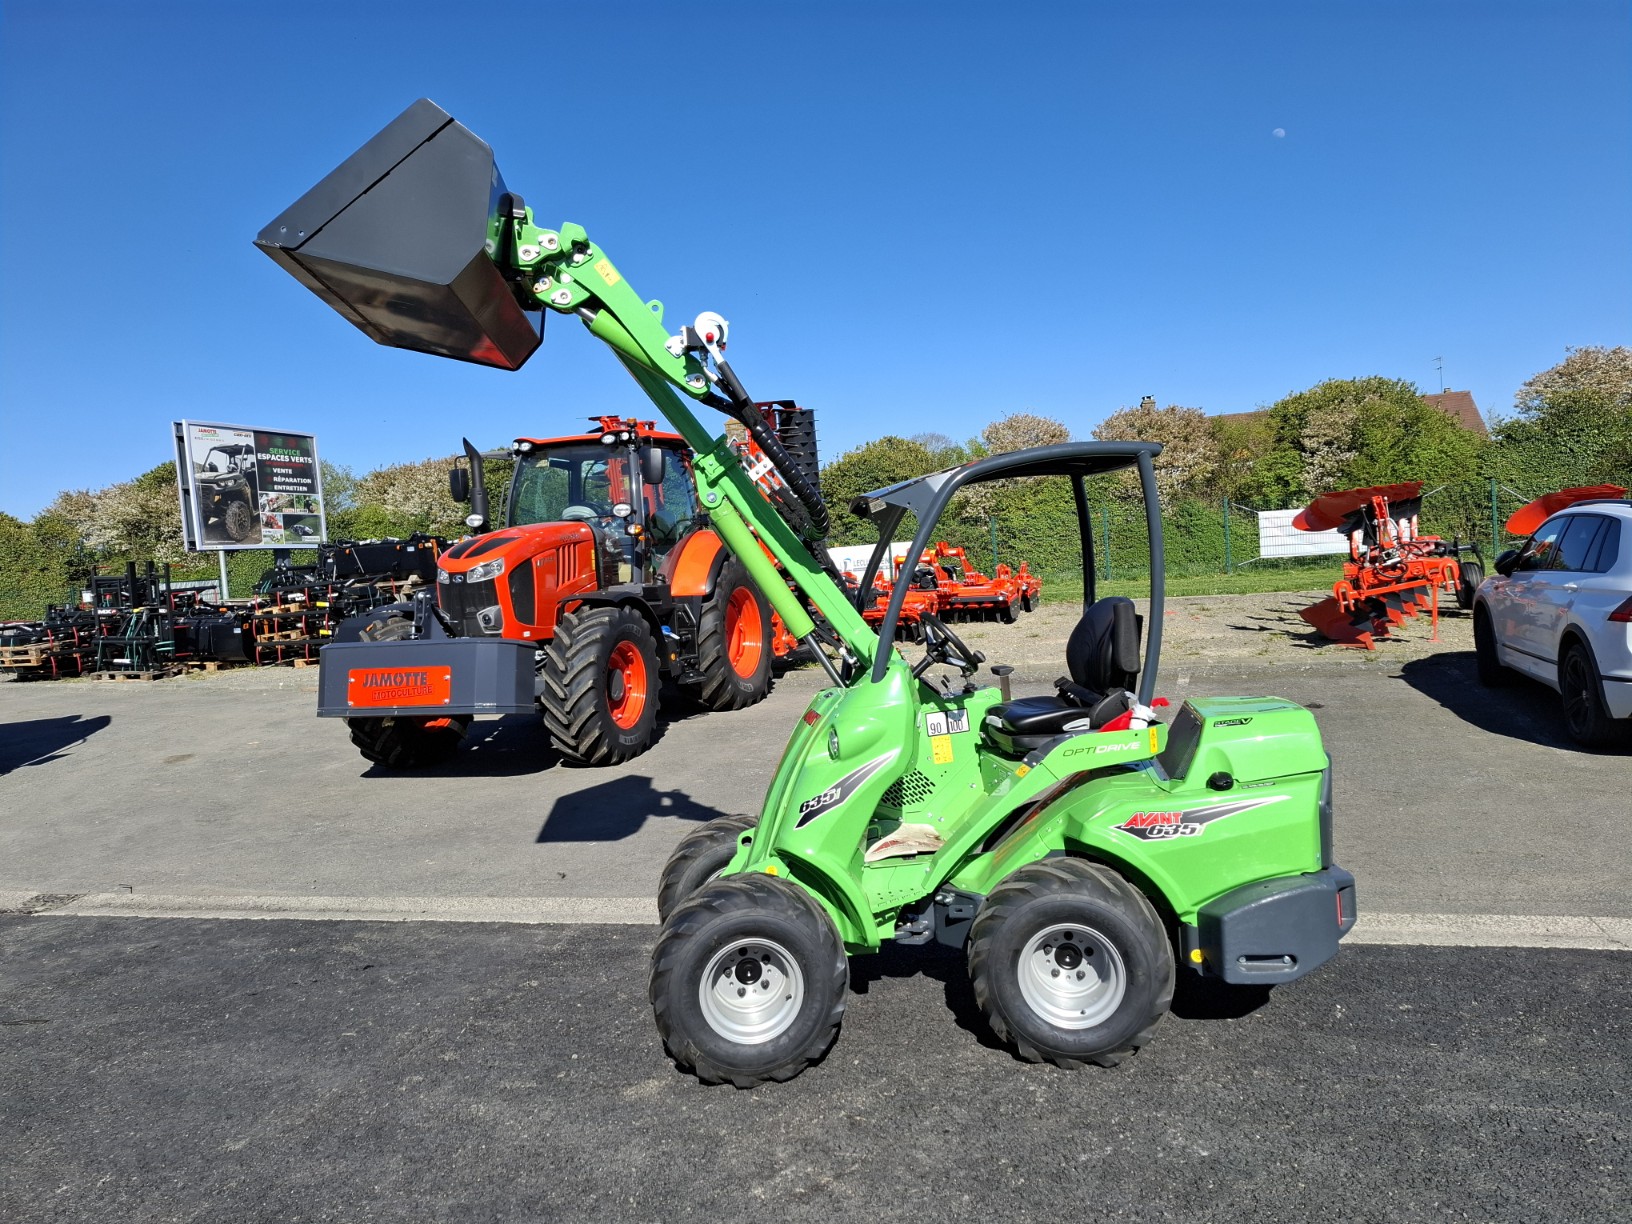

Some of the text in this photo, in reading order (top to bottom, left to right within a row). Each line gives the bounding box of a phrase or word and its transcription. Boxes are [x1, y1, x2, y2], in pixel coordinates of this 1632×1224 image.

[257, 453, 313, 464] ESPACES VERTS
[269, 447, 301, 456] SERVICE
[273, 475, 312, 484] RÉPARATION
[363, 671, 428, 688] JAMOTTE
[373, 685, 433, 701] MOTOCULTURE
[930, 720, 964, 735] 90 100
[1063, 741, 1141, 757] OPTIDRIVE
[1122, 811, 1183, 828] AVANT
